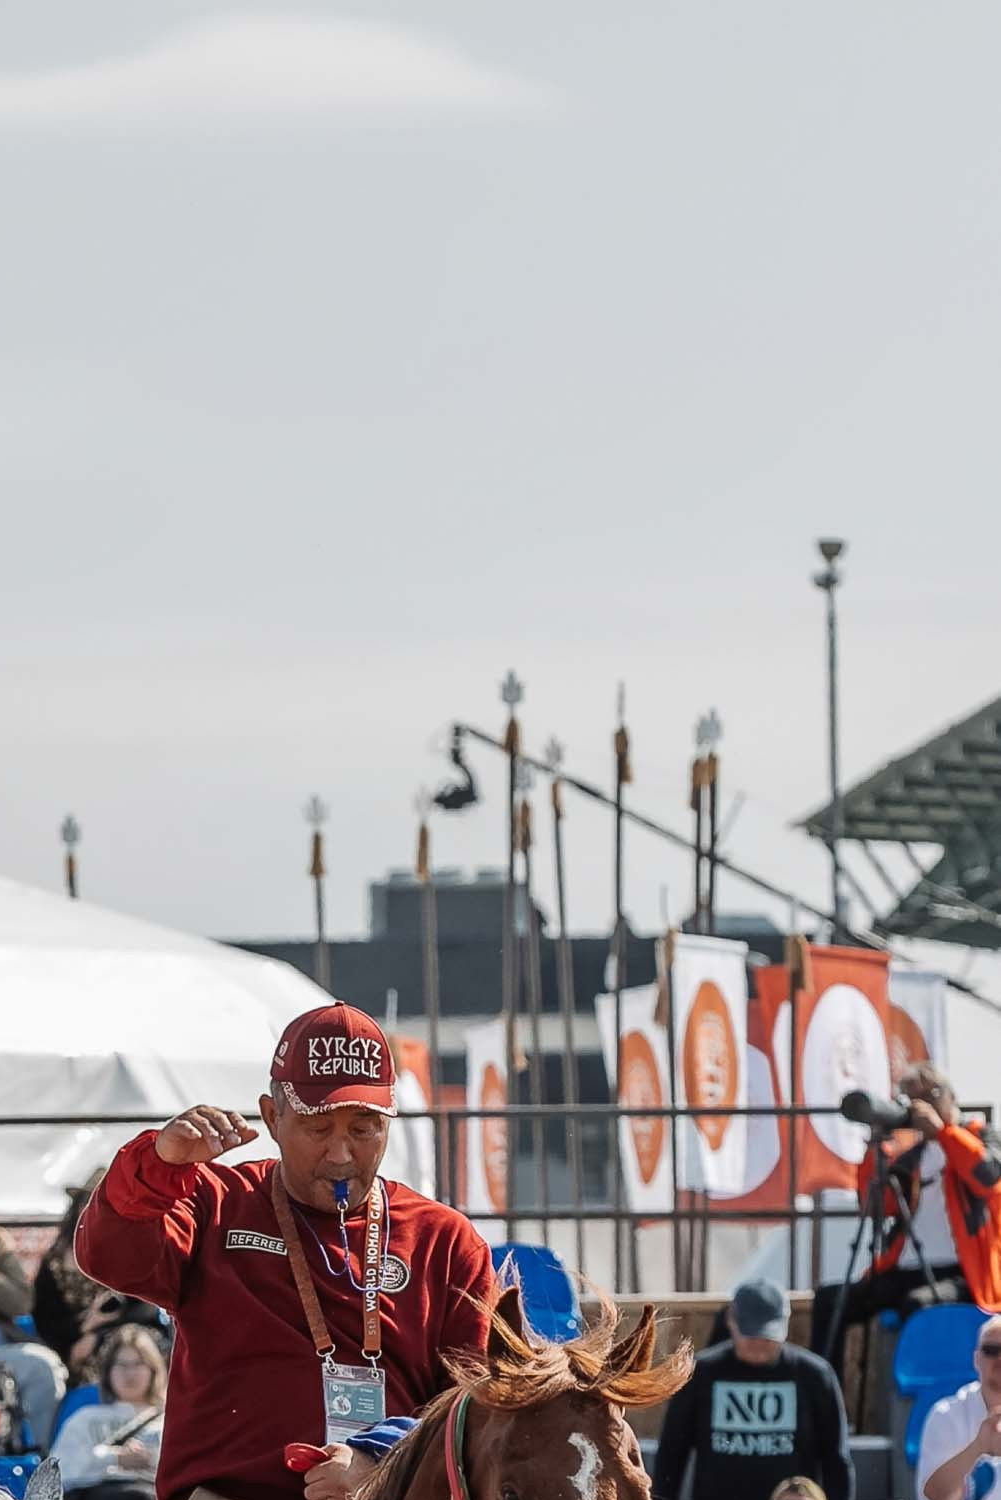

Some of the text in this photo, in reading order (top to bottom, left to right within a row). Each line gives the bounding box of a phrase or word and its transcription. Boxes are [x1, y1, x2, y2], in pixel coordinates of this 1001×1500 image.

[308, 1036, 382, 1060] KYRGYZ
[308, 1058, 382, 1078] REPUBLIC
[230, 1234, 285, 1251] REFEREE
[367, 1222, 379, 1264] NOMAD
[366, 1268, 377, 1312] WORLD
[726, 1390, 784, 1423] NO
